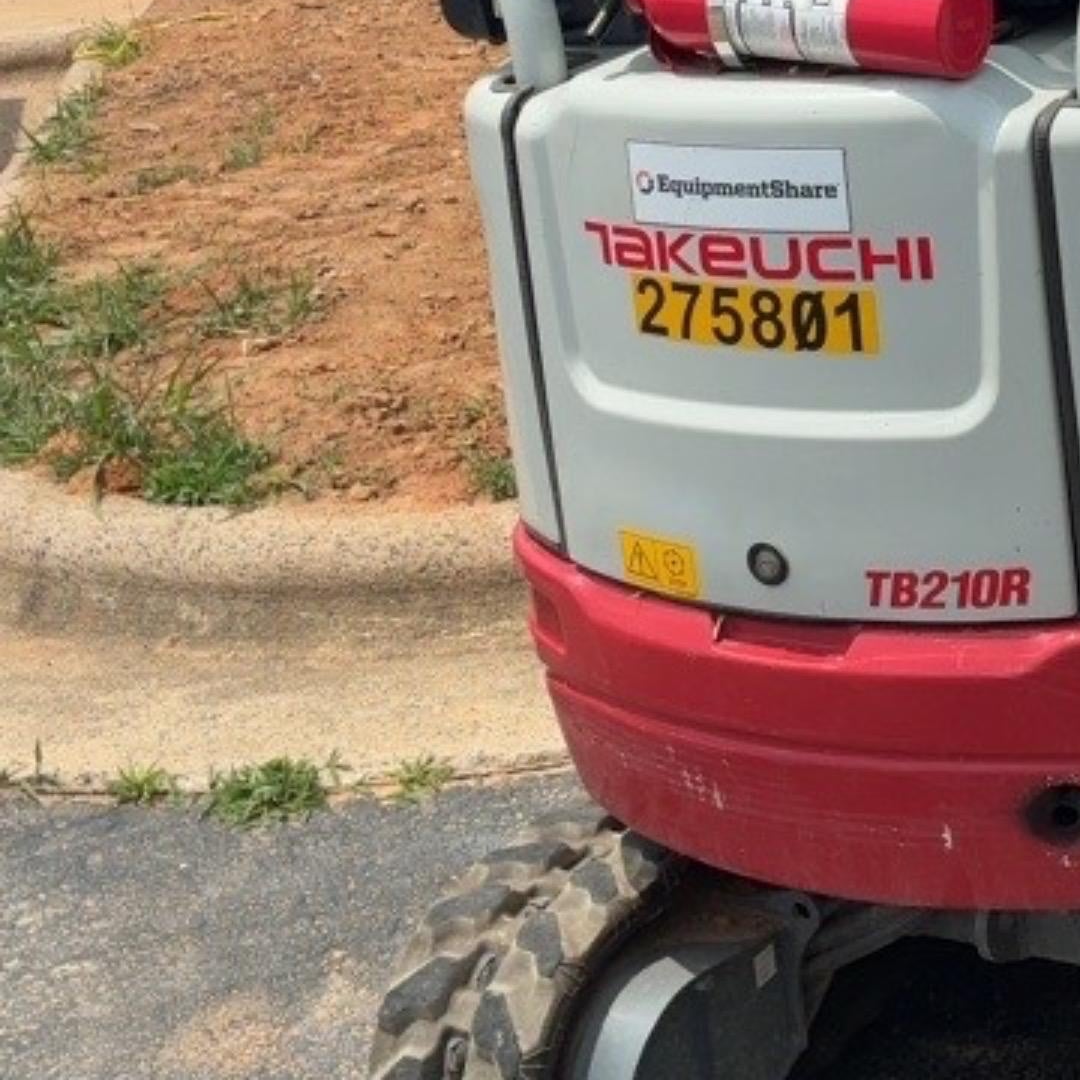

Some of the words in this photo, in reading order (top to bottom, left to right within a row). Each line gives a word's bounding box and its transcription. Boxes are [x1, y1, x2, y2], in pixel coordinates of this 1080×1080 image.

[656, 172, 839, 200] EquipmentShare
[637, 278, 864, 352] 275801
[865, 568, 1032, 609] TB210R
